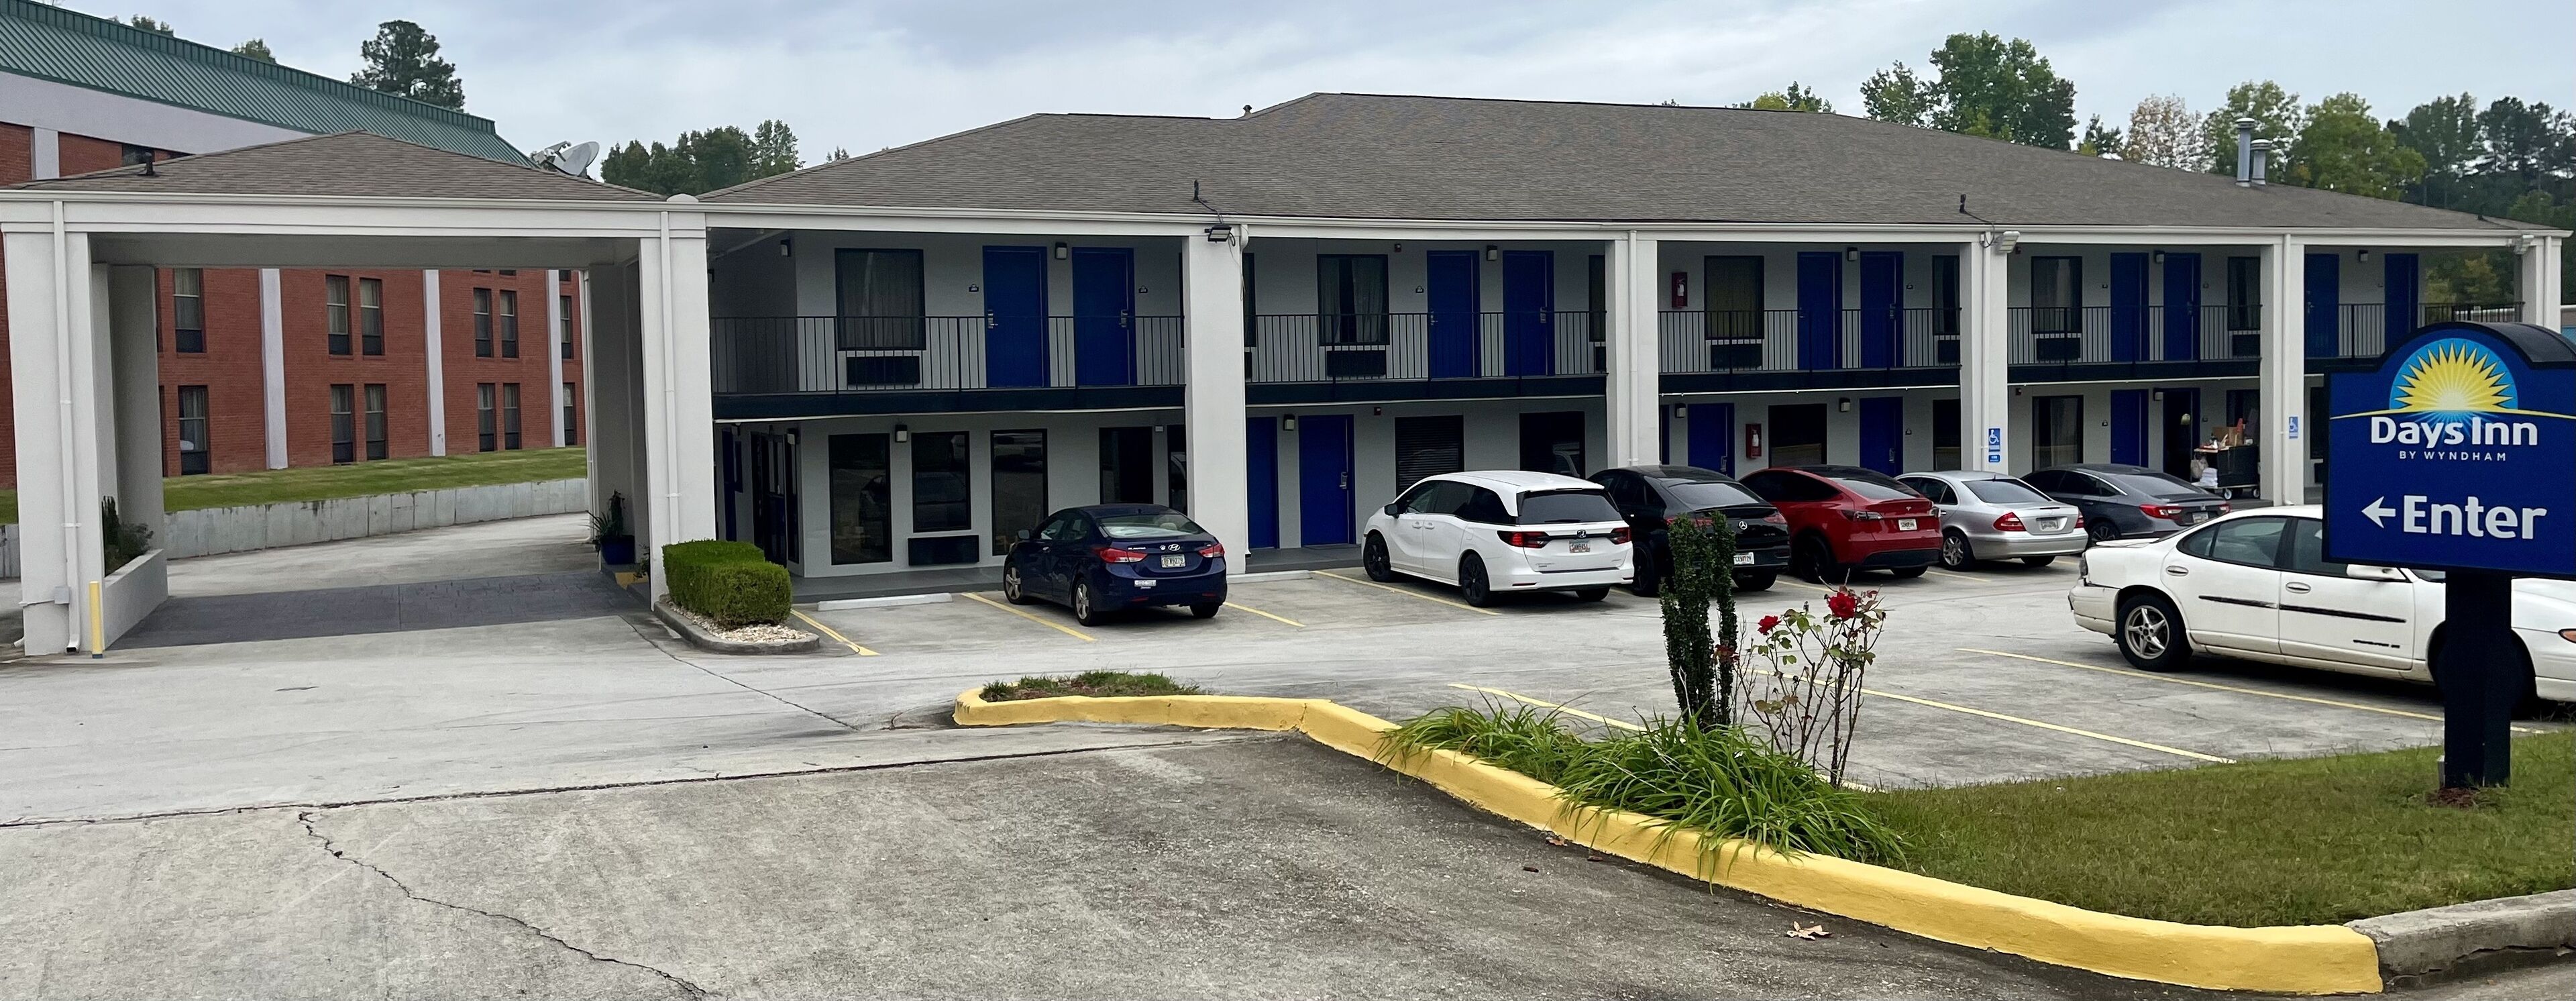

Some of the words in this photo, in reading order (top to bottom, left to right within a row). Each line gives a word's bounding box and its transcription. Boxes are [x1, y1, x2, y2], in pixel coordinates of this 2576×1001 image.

[2371, 416, 2465, 449] Days
[2472, 417, 2538, 445] Inn
[2399, 450, 2416, 460] BY
[2424, 451, 2506, 462] WYNDHAM
[2403, 494, 2547, 539] Enter
